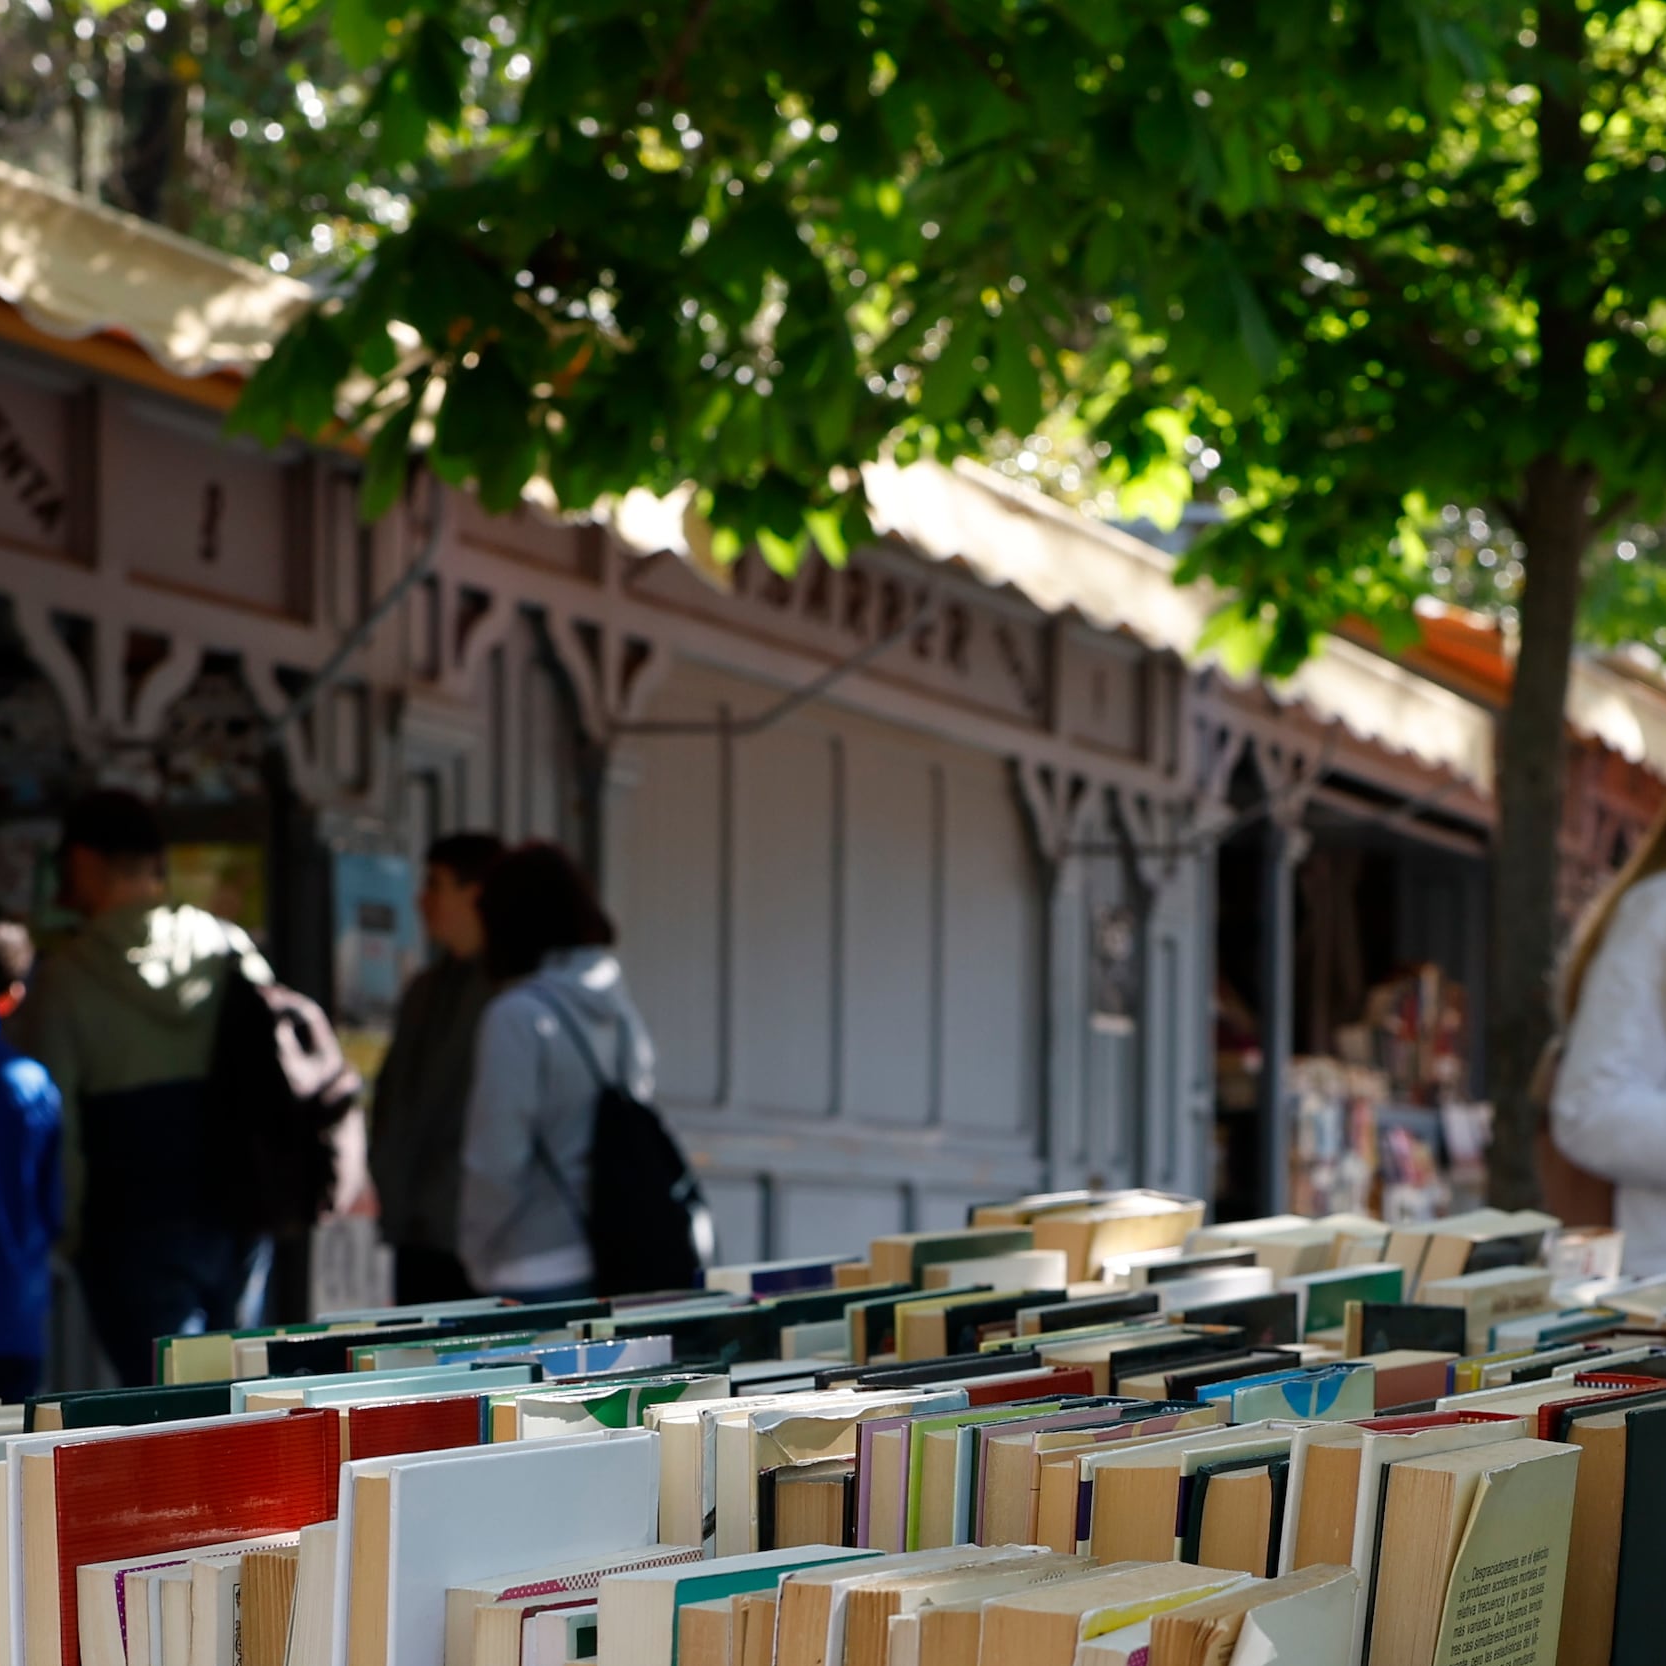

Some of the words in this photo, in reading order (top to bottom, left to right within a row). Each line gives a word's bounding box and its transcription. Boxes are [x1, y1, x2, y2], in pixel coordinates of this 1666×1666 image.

[1521, 1555, 1527, 1566] en
[1528, 1550, 1533, 1564] el
[1457, 1603, 1476, 1620] relativa
[1477, 1595, 1505, 1613] frecuencia
[1510, 1592, 1520, 1607] por
[1520, 1588, 1528, 1600] las
[1529, 1582, 1545, 1597] causas
[1459, 1591, 1465, 1603] se
[1466, 1583, 1491, 1604] producen
[1492, 1575, 1518, 1592] accidentes
[1519, 1568, 1538, 1584] mortales
[1538, 1565, 1547, 1577] con
[1453, 1624, 1465, 1638] más
[1494, 1612, 1505, 1625] Que
[1506, 1605, 1528, 1624] hayamos
[1528, 1599, 1543, 1613] tenido
[1451, 1644, 1461, 1656] tres
[1462, 1641, 1473, 1653] casi
[1474, 1631, 1504, 1650] simultáneos
[1518, 1623, 1523, 1633] no
[1485, 1650, 1493, 1663] las
[1493, 1640, 1522, 1660] estadísticas
[1523, 1635, 1531, 1648] del
